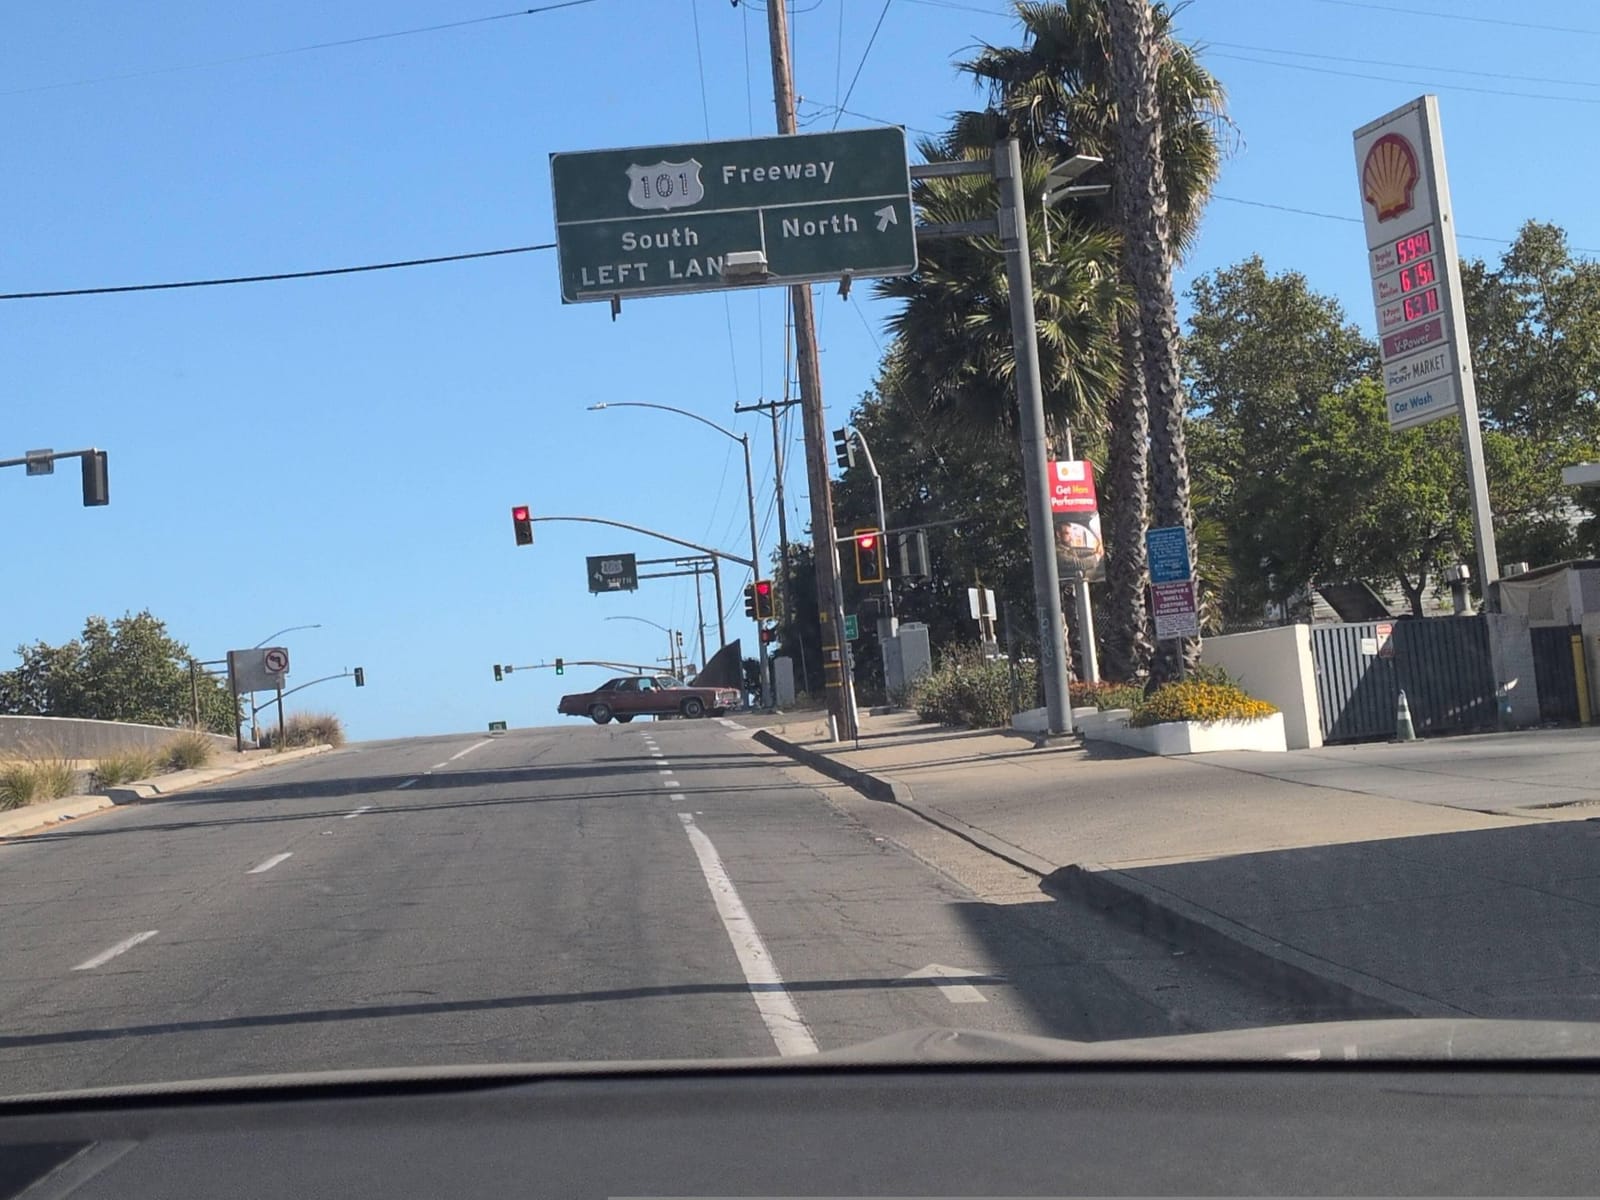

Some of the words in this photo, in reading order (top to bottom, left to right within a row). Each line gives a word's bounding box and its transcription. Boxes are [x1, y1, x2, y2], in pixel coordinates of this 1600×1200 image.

[641, 173, 689, 198] 101
[721, 160, 835, 185] Freeway
[781, 213, 858, 239] North
[621, 227, 699, 252] South
[581, 262, 649, 287] LEFT
[669, 256, 725, 280] LAN
[1394, 334, 1429, 352] V-Power
[1411, 354, 1445, 378] MARKET
[1394, 402, 1408, 413] Car
[1409, 391, 1432, 408] Wash
[1056, 485, 1071, 495] Get
